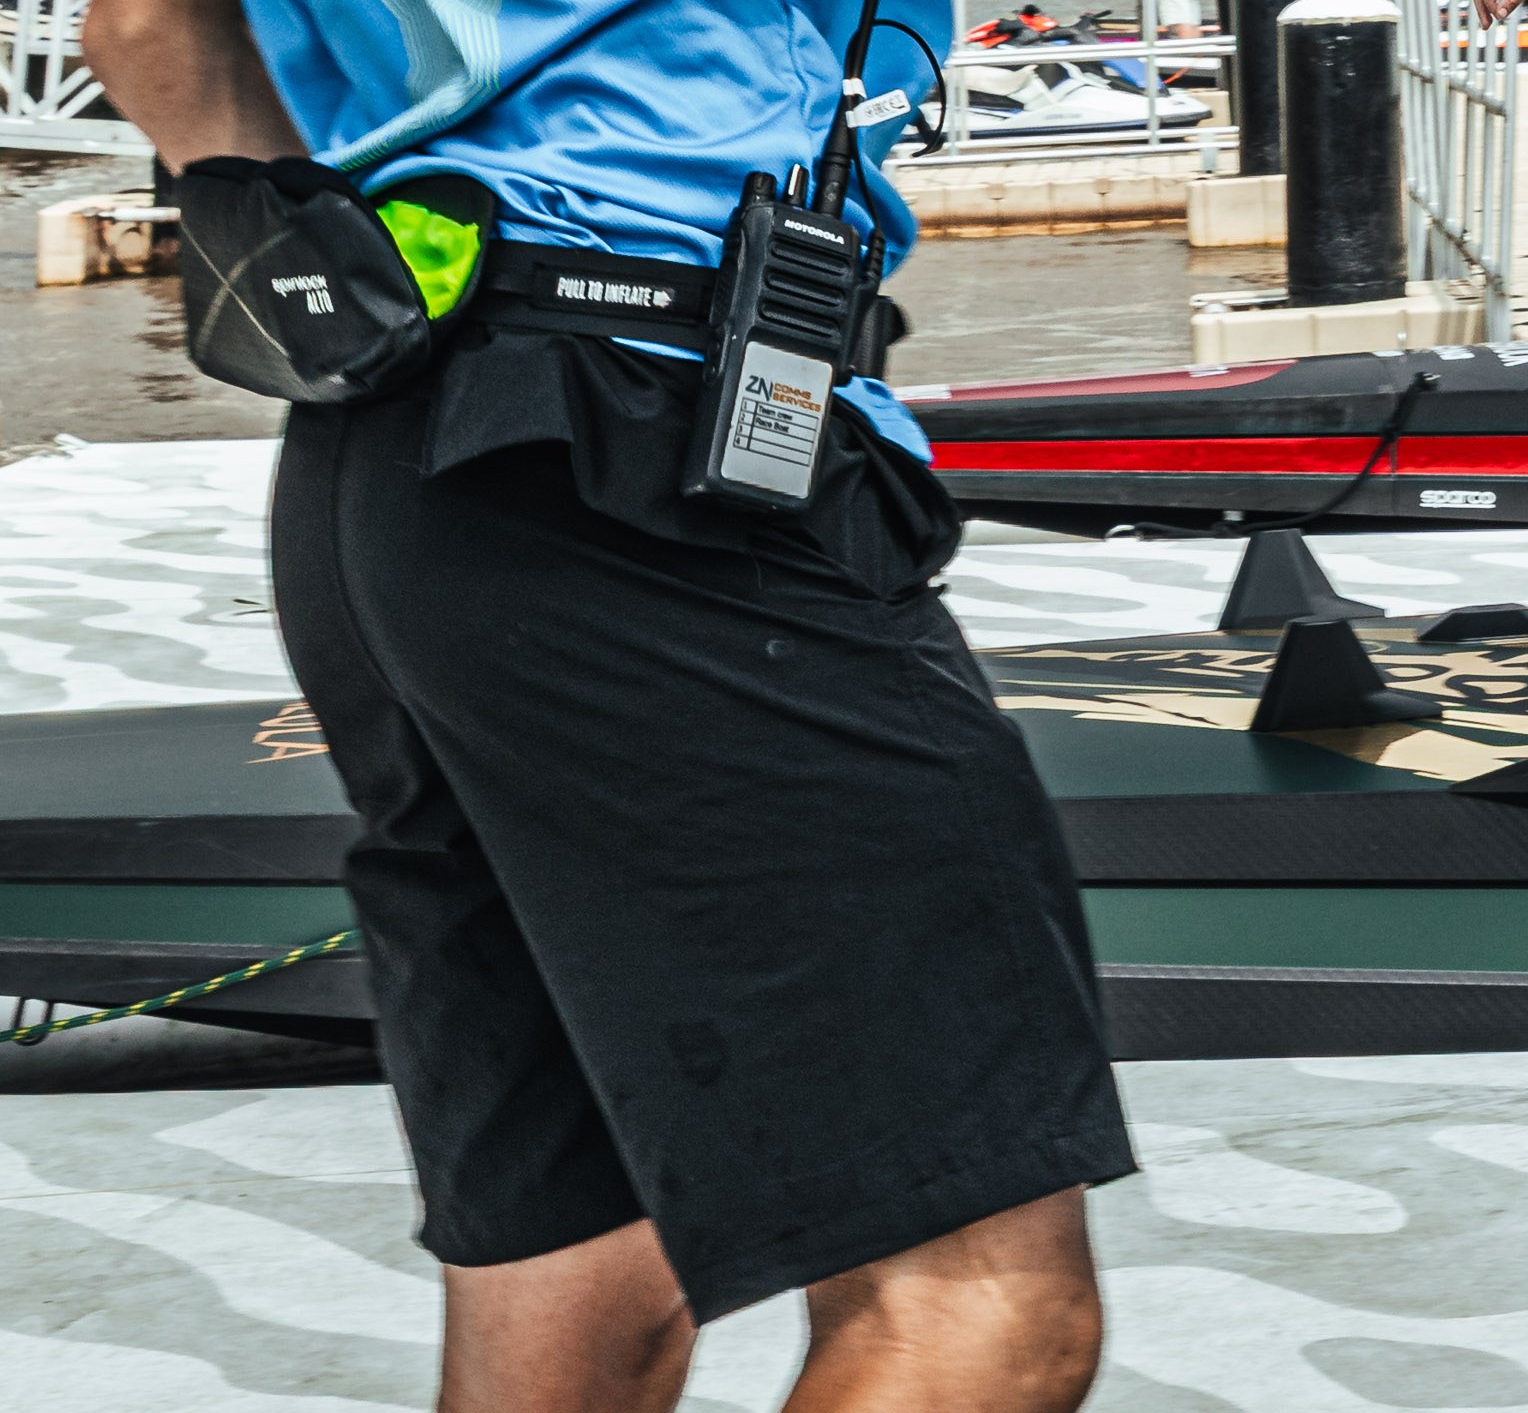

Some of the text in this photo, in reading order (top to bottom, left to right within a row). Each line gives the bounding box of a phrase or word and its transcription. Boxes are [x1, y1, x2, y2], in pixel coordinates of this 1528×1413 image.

[784, 219, 845, 245] MOTOROLA
[557, 277, 653, 307] PULL TO INFLATE
[745, 375, 774, 402] ZN
[758, 404, 777, 416] Team
[772, 392, 822, 413] SERVICES
